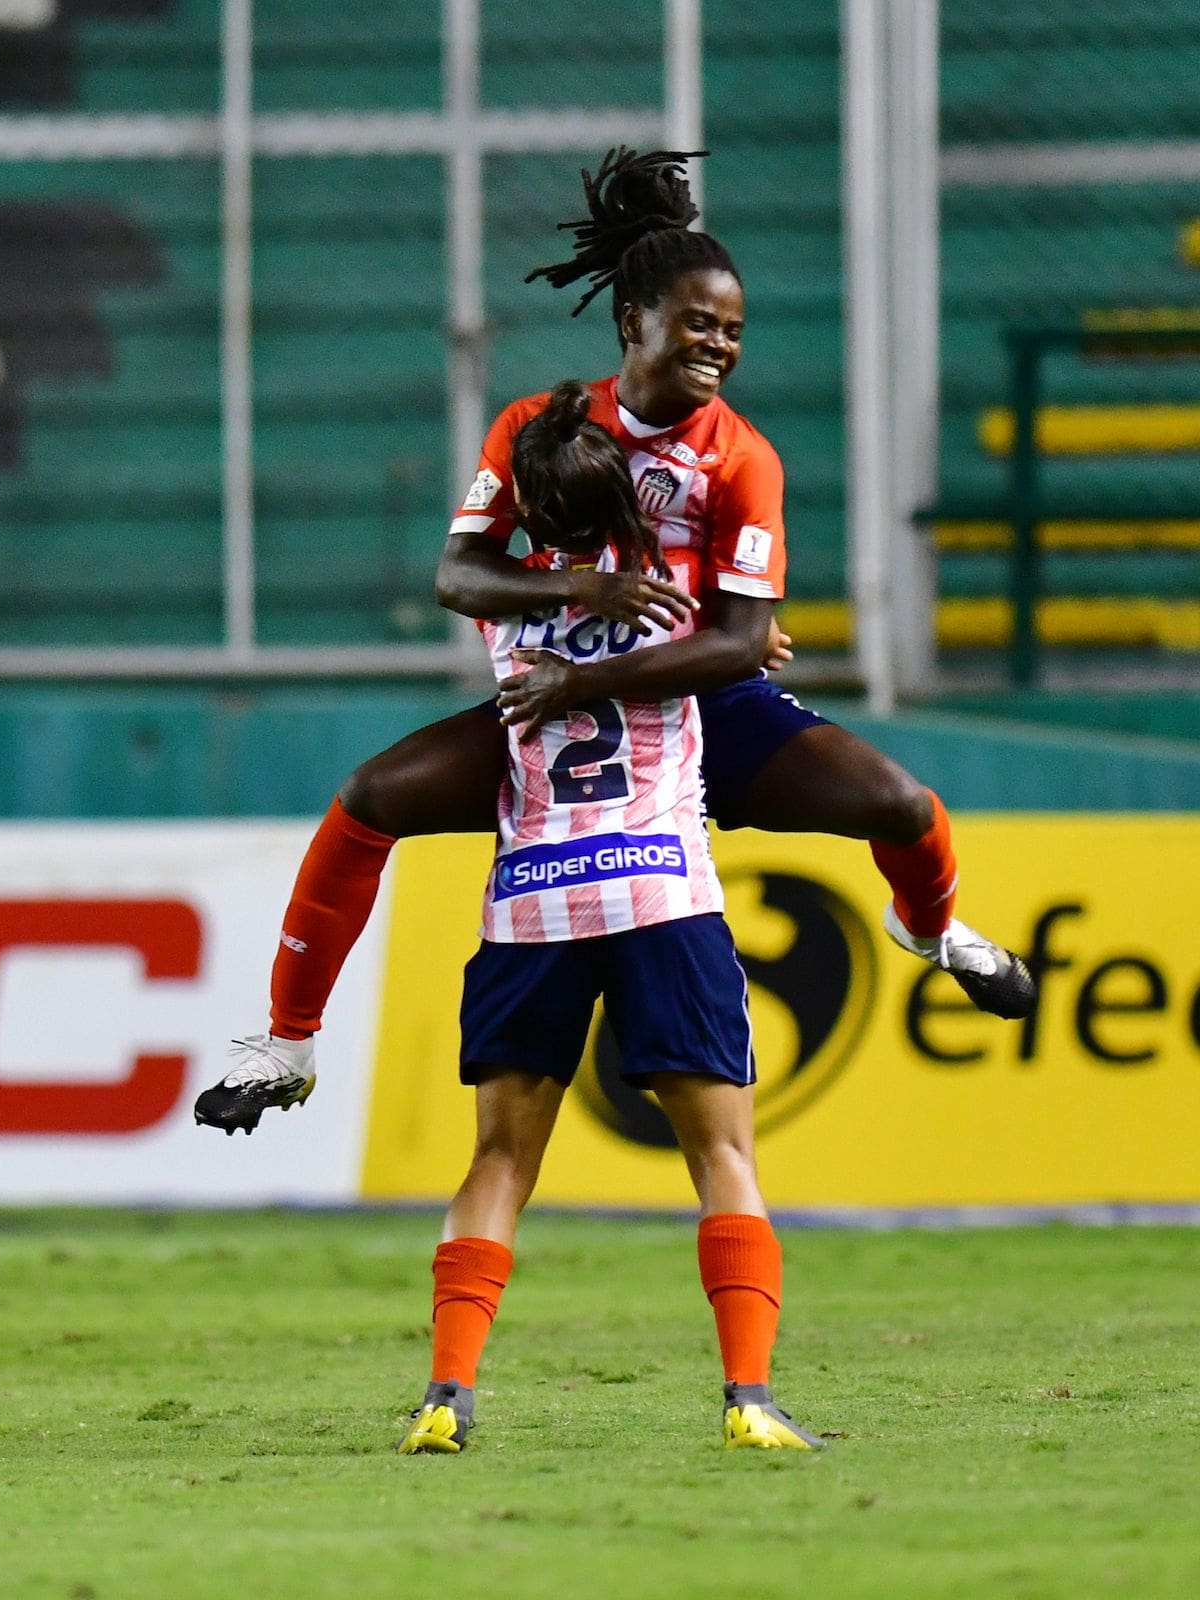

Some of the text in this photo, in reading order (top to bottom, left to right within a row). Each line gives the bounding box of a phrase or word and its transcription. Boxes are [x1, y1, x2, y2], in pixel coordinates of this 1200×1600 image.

[546, 695, 629, 804] 2
[513, 845, 683, 885] Super GIROS
[904, 904, 1200, 1063] efe
